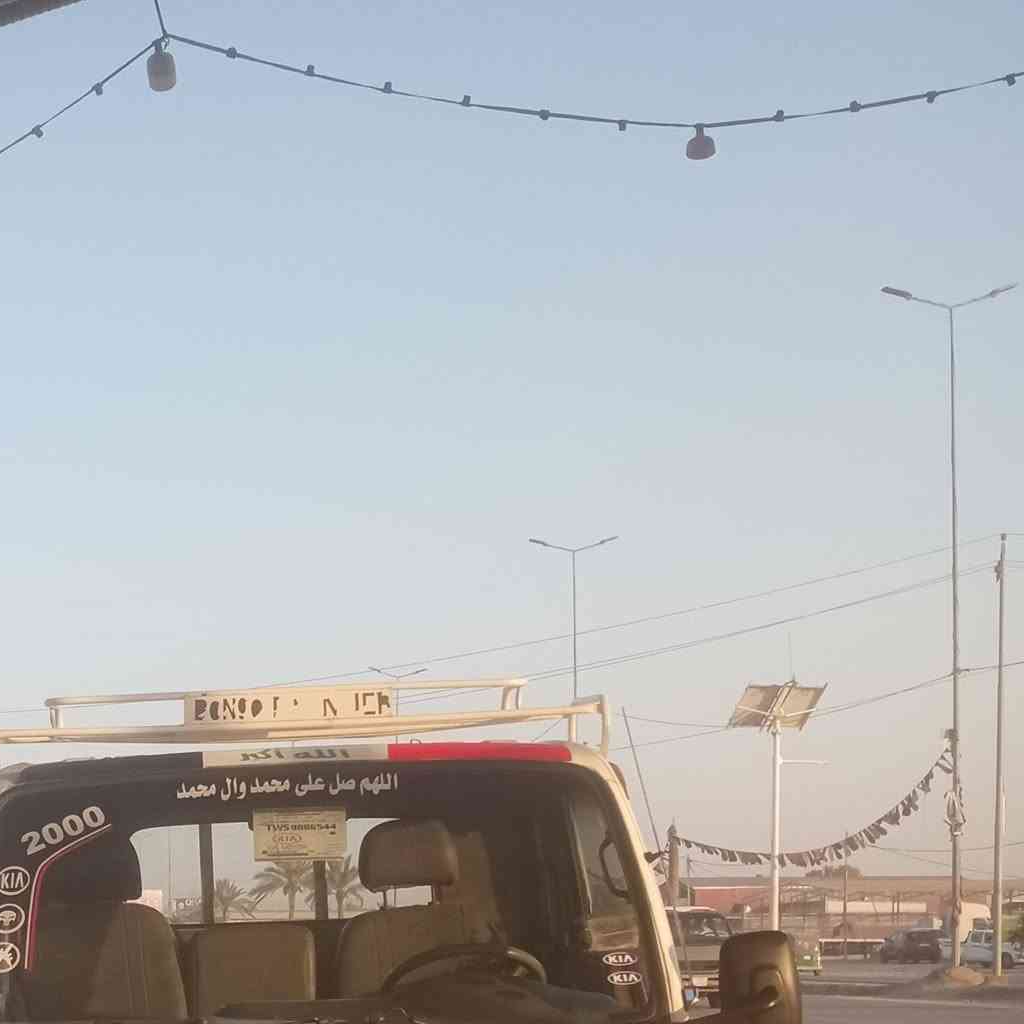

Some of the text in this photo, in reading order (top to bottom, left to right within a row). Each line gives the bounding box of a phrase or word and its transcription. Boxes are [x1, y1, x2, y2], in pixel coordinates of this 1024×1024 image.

[176, 782, 217, 799] محمد
[250, 777, 290, 793] محمد
[295, 772, 325, 797] على
[329, 772, 356, 796] صل
[359, 772, 398, 796] اللهم
[20, 805, 106, 856] 2000
[0, 871, 25, 890] KIA
